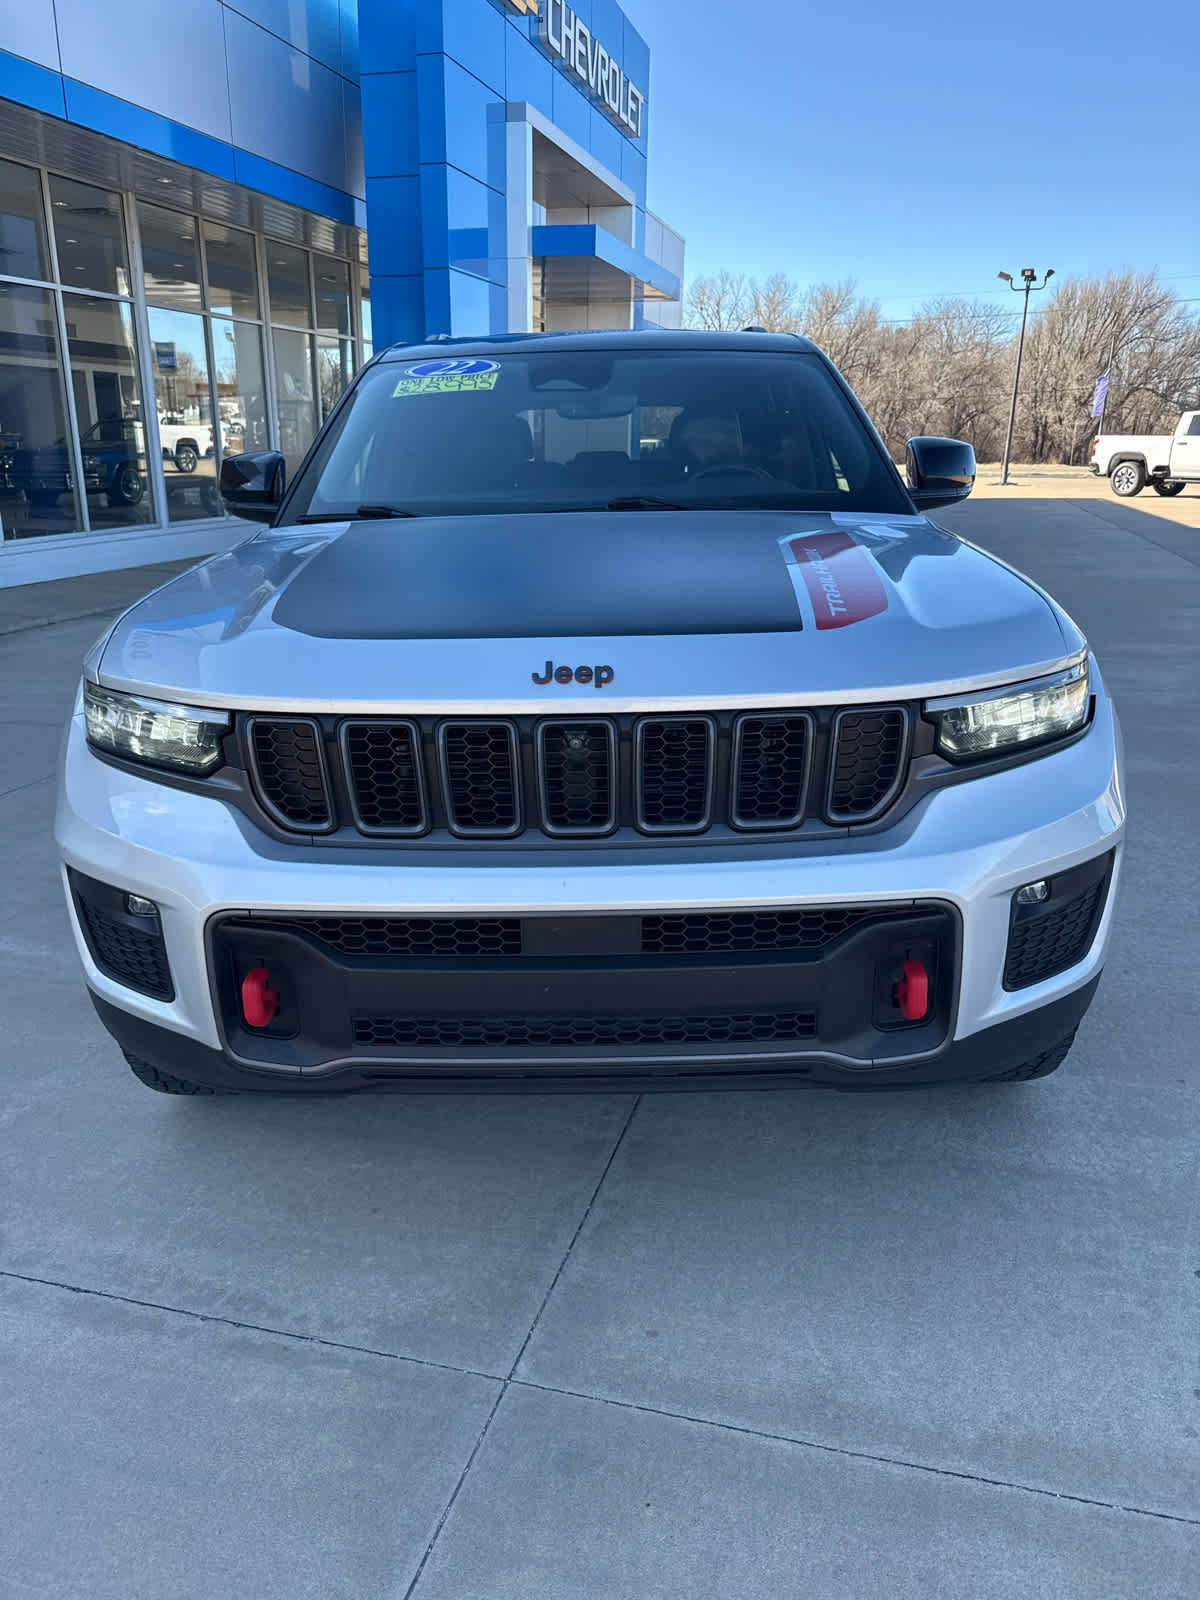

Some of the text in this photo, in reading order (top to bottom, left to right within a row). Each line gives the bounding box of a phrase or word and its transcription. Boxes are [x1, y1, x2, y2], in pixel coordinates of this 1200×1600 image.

[547, 0, 645, 138] CHEVROLET
[428, 360, 477, 375] 22
[531, 660, 615, 689] Jeep
